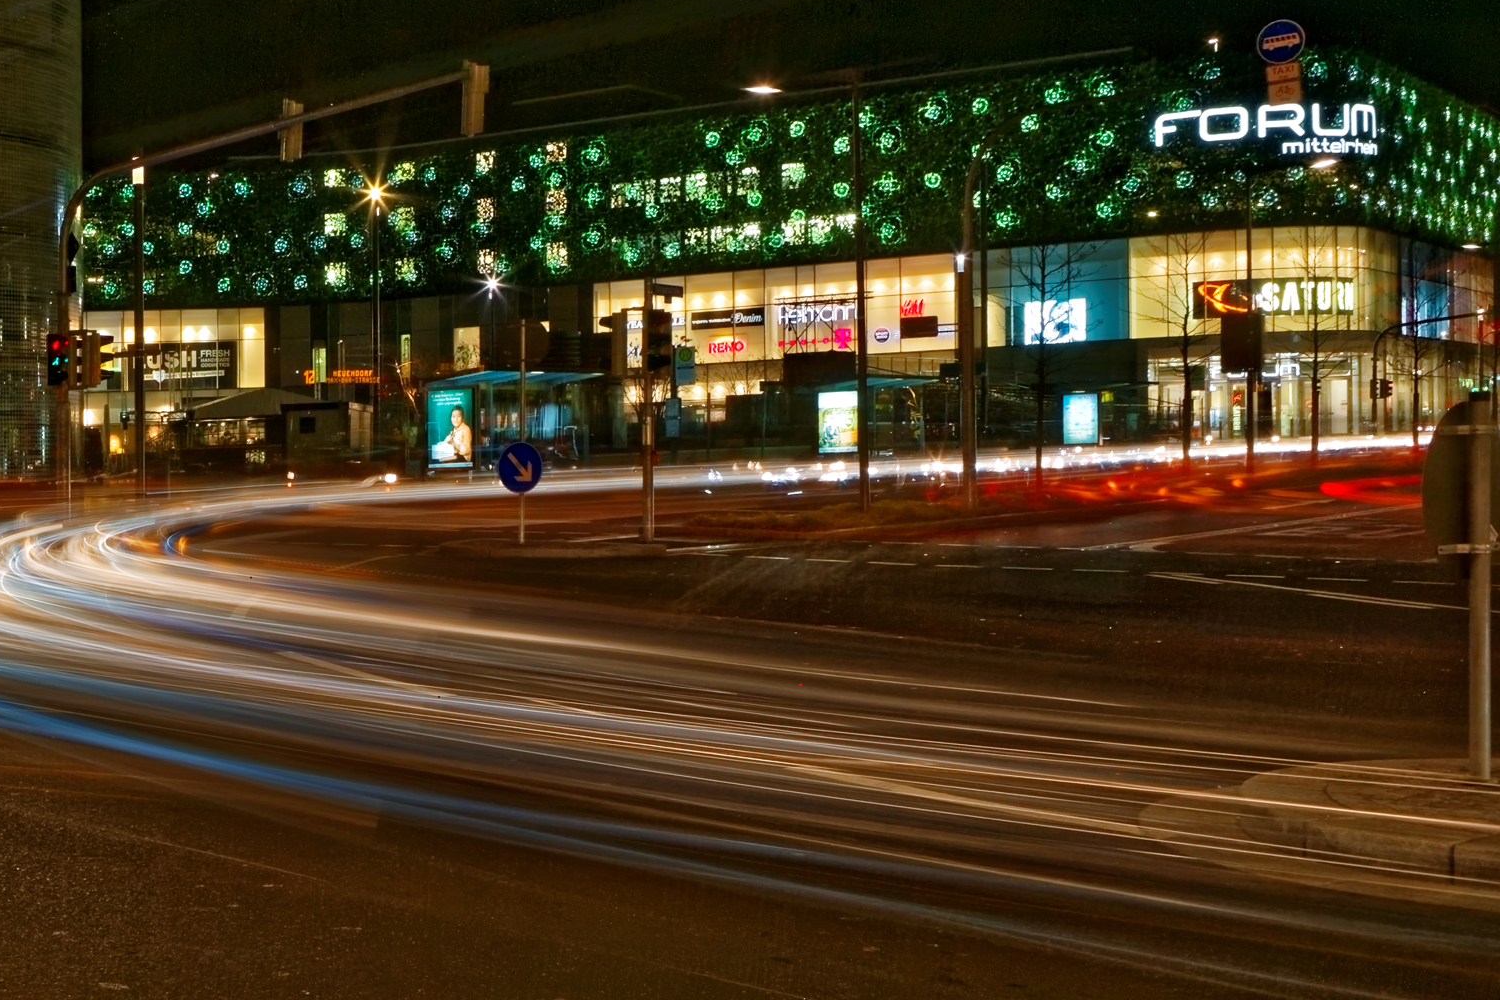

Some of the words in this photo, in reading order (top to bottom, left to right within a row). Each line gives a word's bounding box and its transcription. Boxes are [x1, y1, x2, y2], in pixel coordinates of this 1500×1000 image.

[1272, 65, 1295, 76] TAXI
[1155, 103, 1377, 147] FORUM
[1282, 138, 1378, 156] mittelrhein
[1261, 281, 1354, 312] SATURN
[734, 312, 763, 324] Denim
[201, 349, 230, 358] FRESH
[708, 341, 745, 354] RENO
